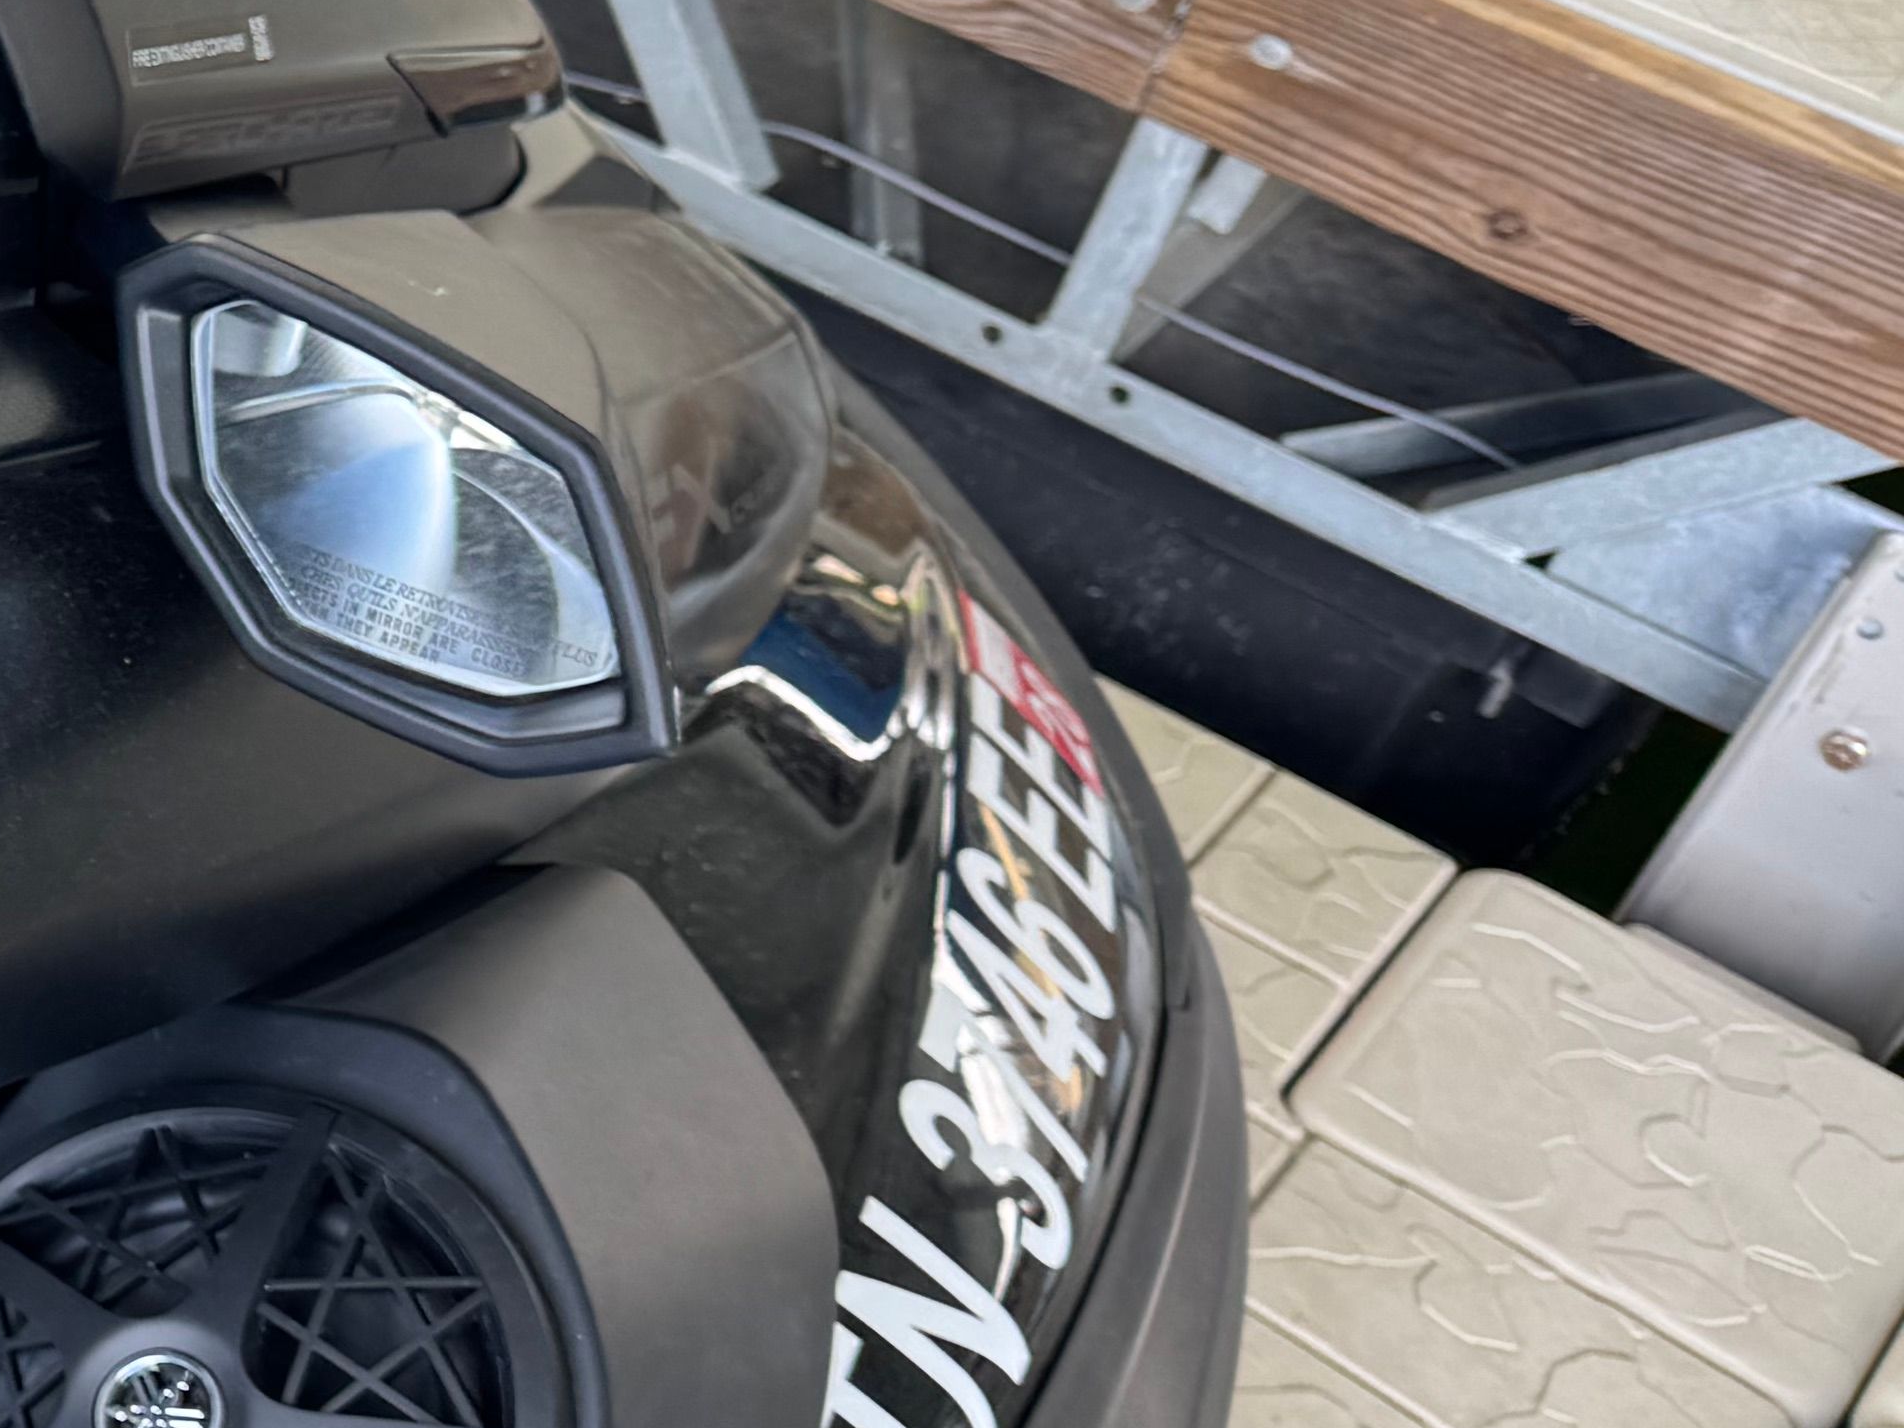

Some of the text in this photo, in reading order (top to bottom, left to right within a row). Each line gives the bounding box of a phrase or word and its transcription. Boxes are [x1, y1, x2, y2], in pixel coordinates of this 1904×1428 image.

[366, 609, 423, 641] MIRROR
[430, 631, 458, 654] ARE
[381, 630, 441, 664] APPEAR
[899, 848, 1115, 1269] 3746
